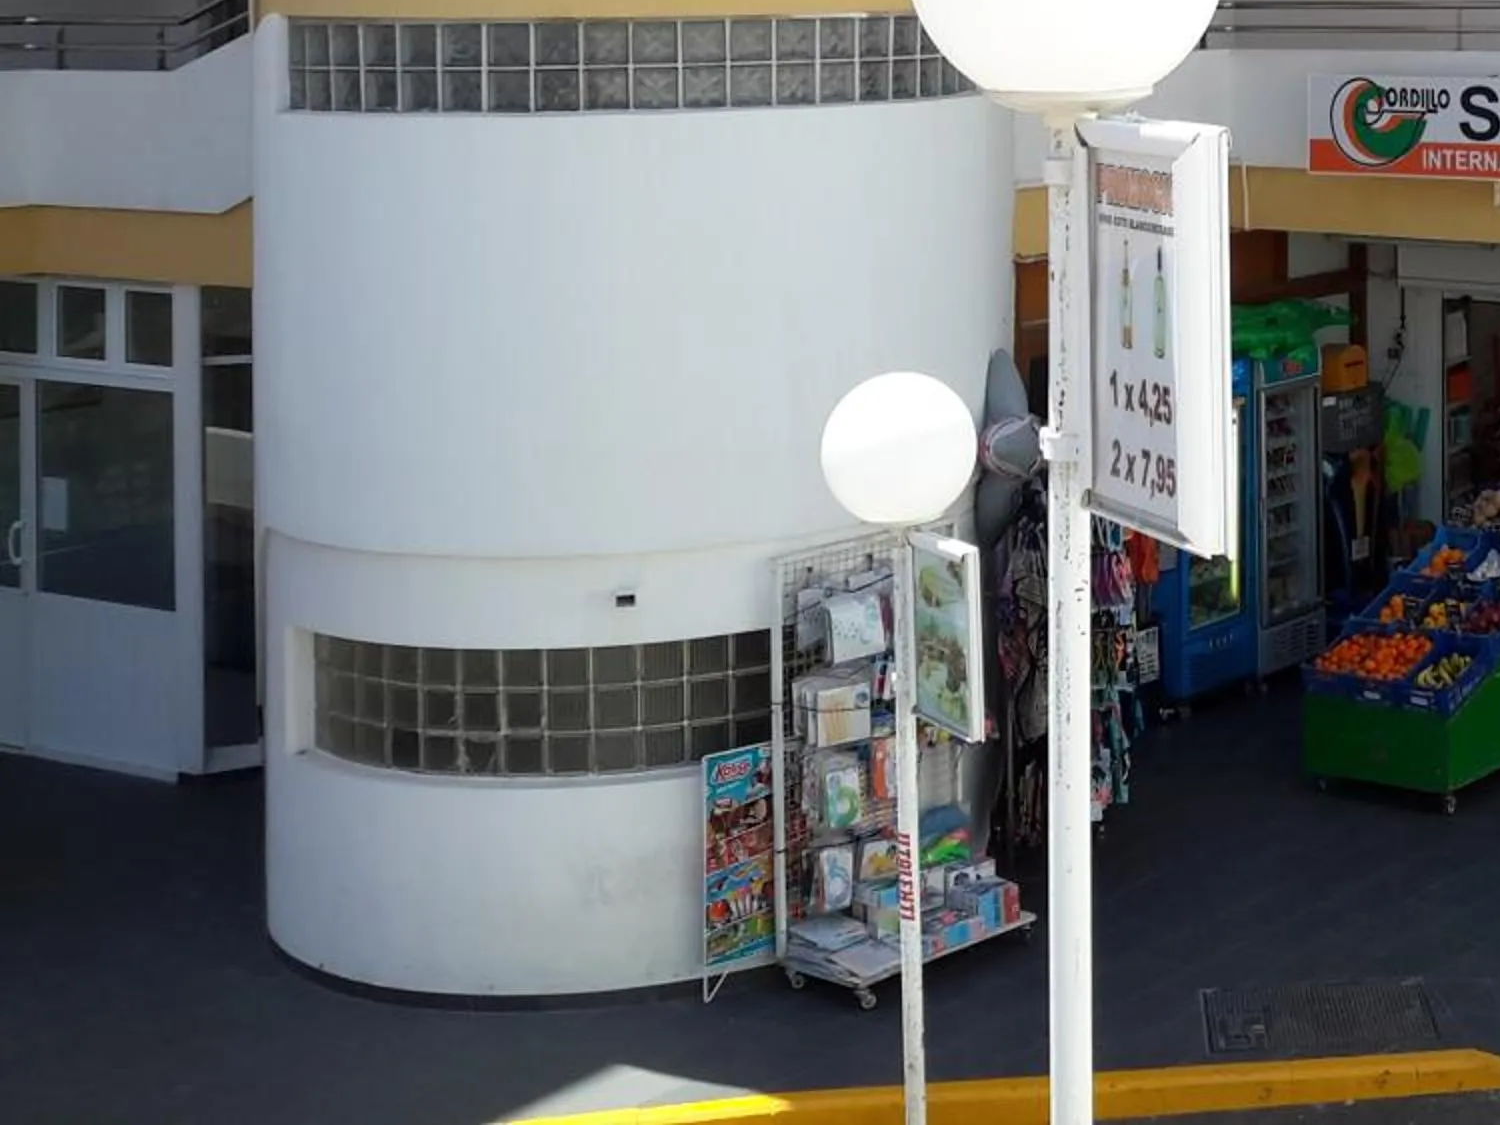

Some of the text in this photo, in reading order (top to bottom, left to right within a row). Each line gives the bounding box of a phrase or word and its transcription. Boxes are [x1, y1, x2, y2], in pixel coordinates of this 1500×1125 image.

[1109, 370, 1119, 409] 1
[1138, 378, 1173, 429] 4,25
[1110, 438, 1121, 477] 2
[1140, 450, 1177, 501] 7,95
